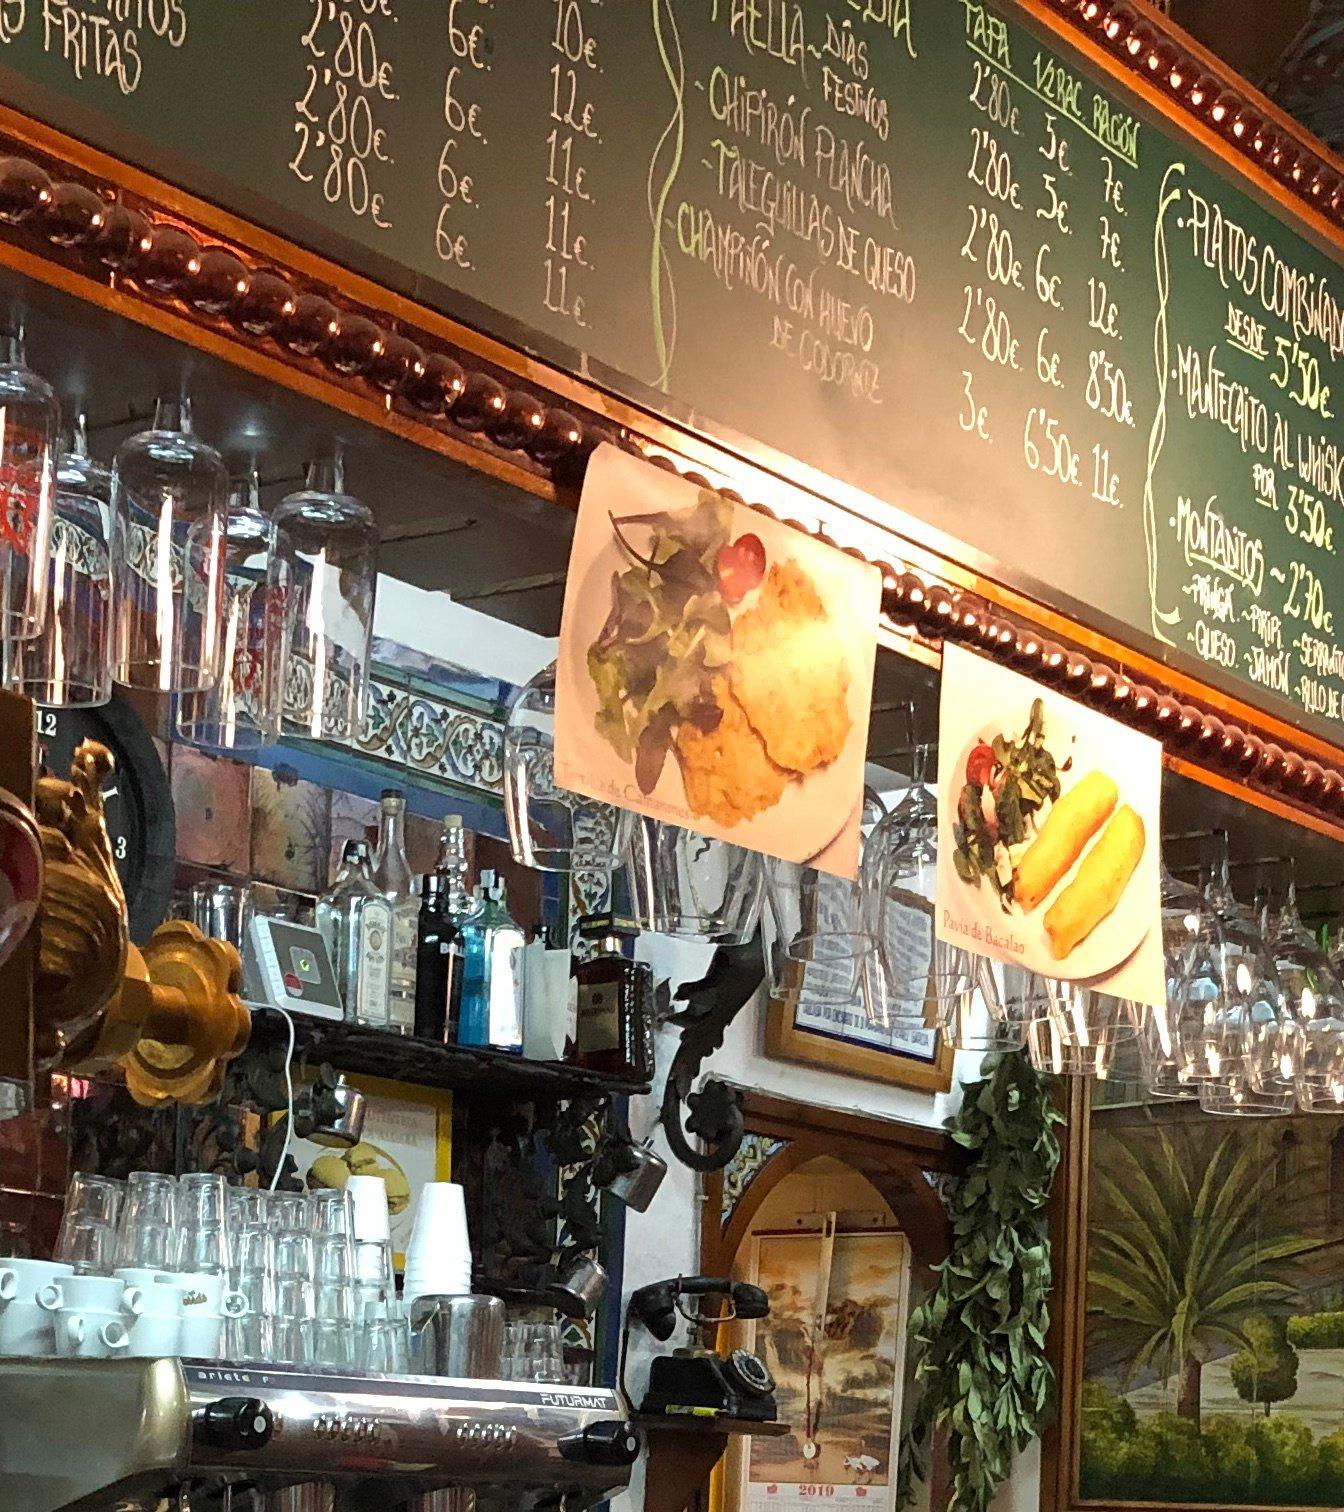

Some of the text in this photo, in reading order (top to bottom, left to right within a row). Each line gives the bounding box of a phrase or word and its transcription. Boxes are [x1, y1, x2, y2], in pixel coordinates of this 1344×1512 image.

[1187, 188, 1258, 295] PLATOS
[864, 236, 916, 304] QUESO
[1273, 412, 1294, 471] AL
[36, 711, 57, 738] 12
[115, 836, 127, 860] 3
[541, 1393, 606, 1410] FUTURMAT
[798, 1484, 835, 1497] 2019
